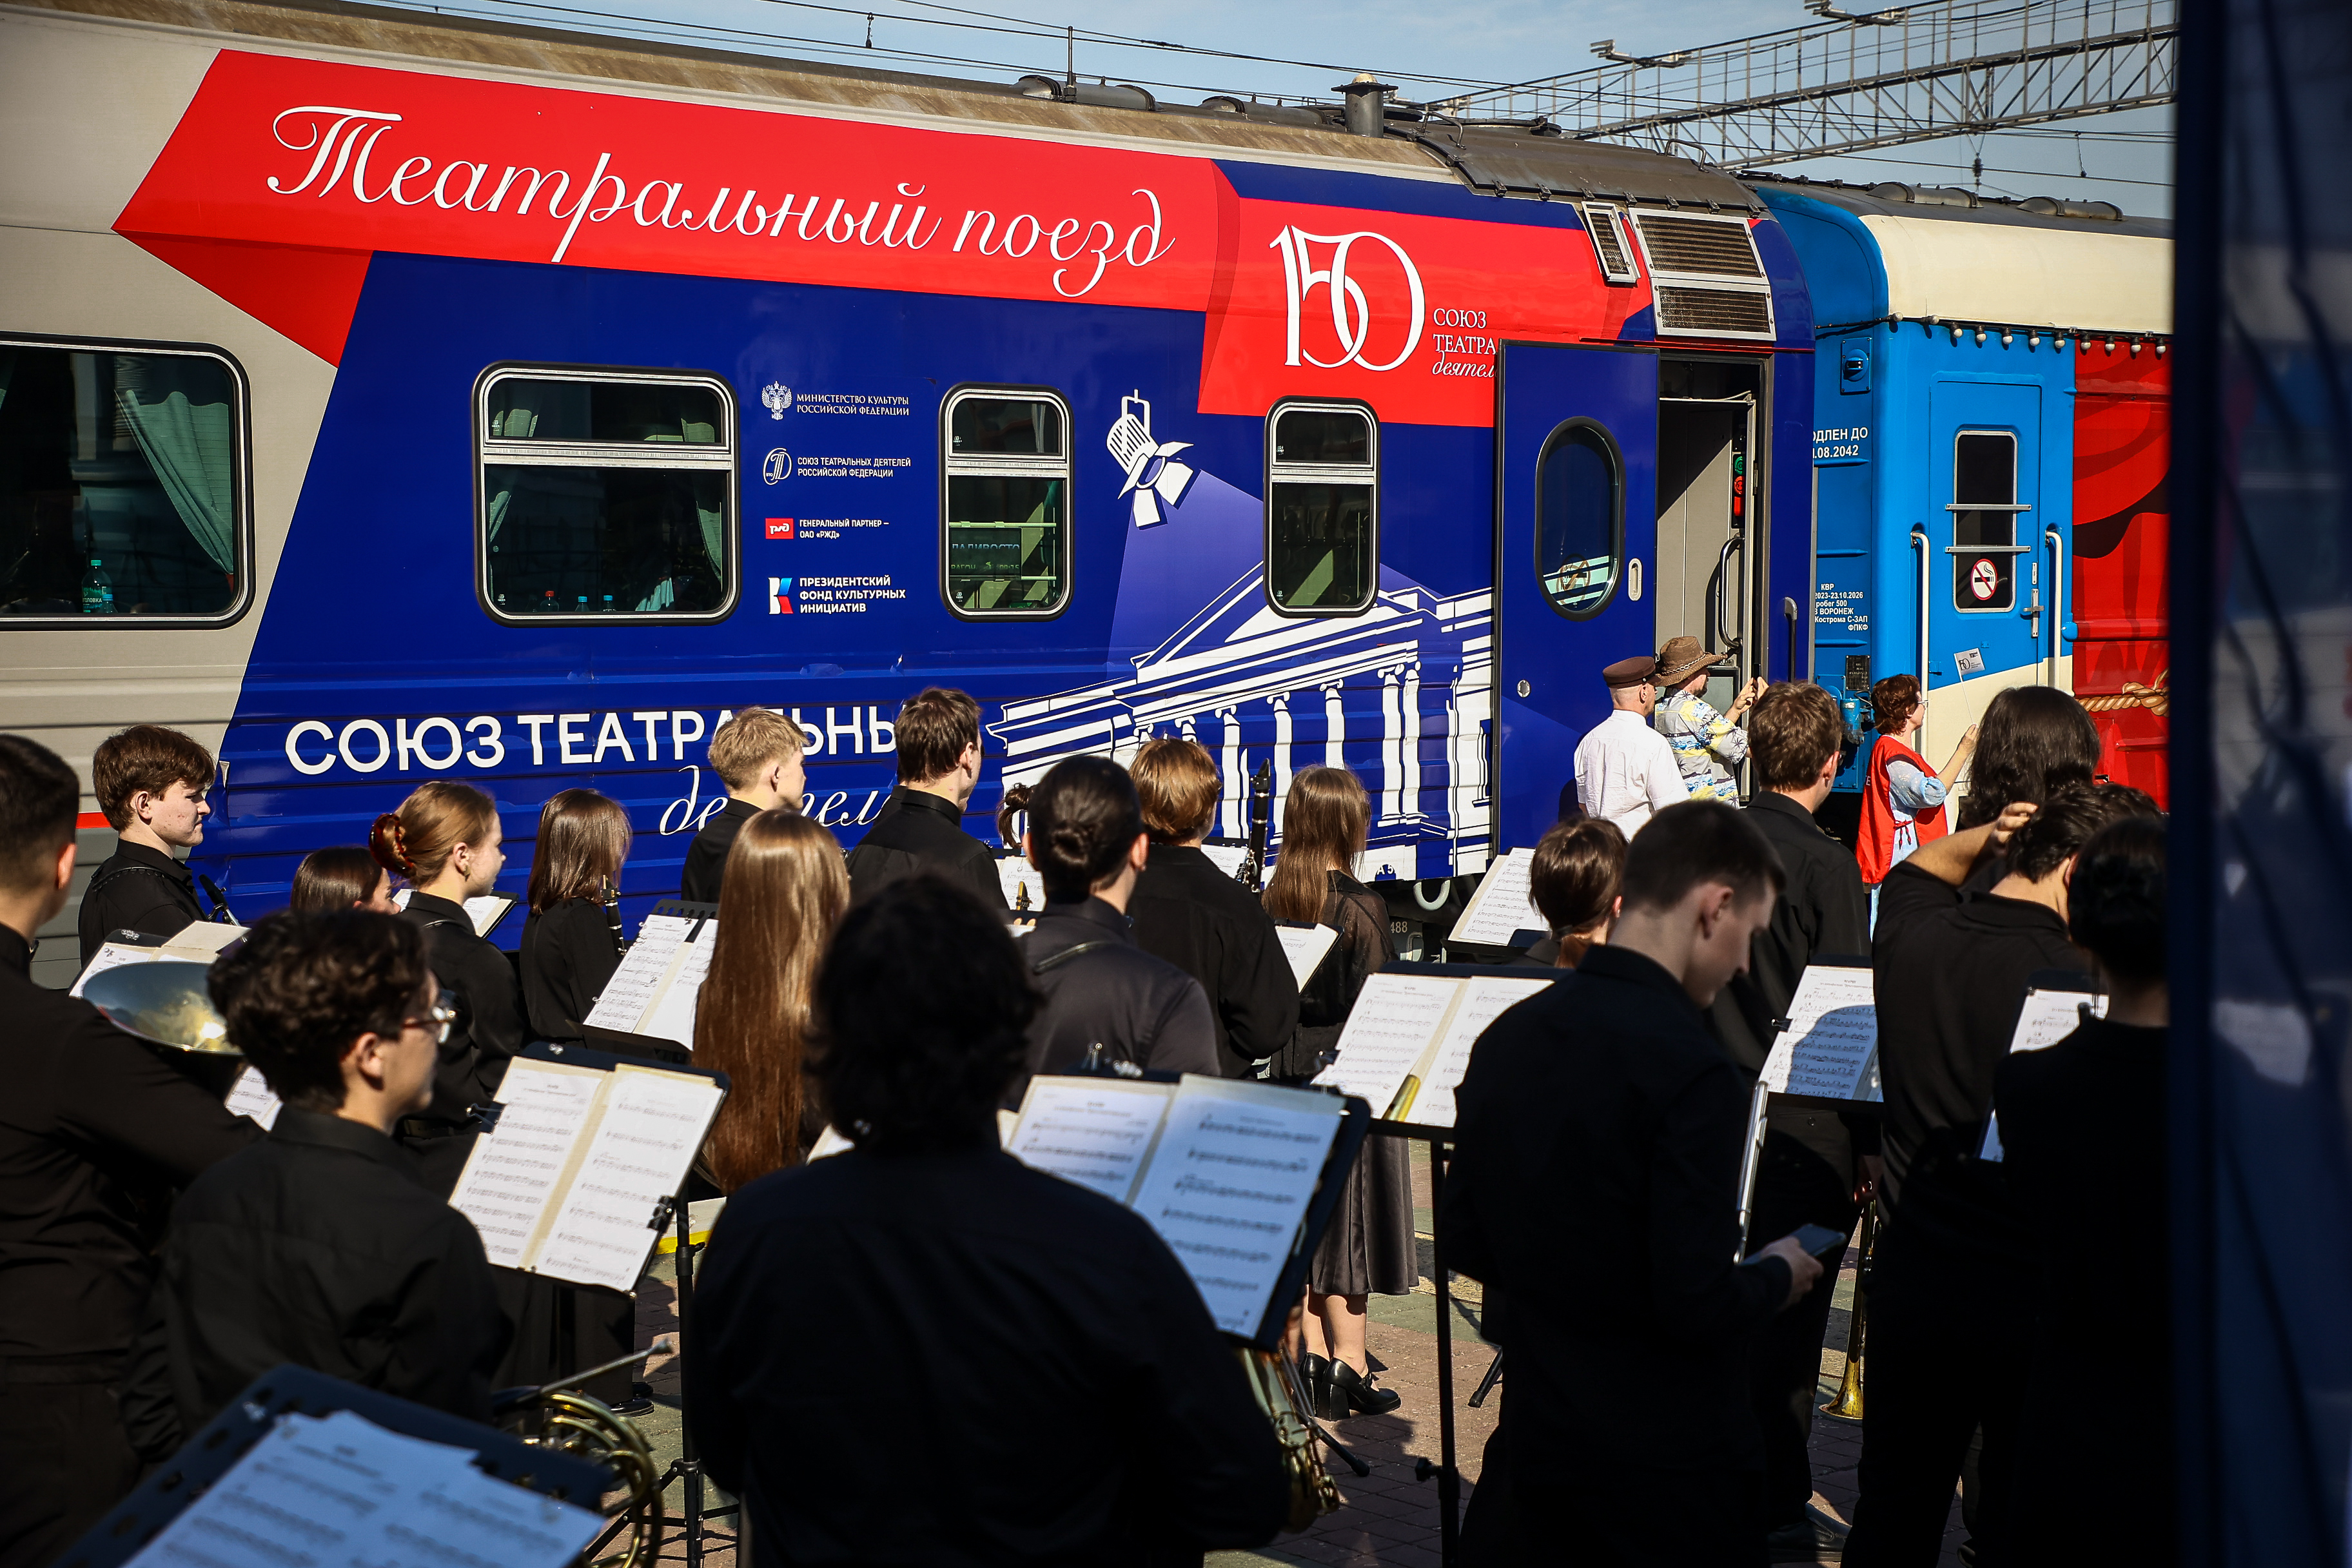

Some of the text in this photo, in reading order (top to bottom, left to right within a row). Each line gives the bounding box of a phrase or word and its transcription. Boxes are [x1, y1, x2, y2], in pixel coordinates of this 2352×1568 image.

[267, 105, 1175, 297] Театральный поезд
[1269, 224, 1425, 371] 150
[1433, 308, 1486, 329] СОЮЗ
[1433, 333, 1496, 355] ТЕАТРА
[796, 393, 909, 406] МИНИСТЕРСТВО КУЛЬТУРЫ
[797, 404, 909, 416] РОССИЙСКОЙ ФЕДЕРАЦИИ
[1850, 427, 1868, 442] ДО
[798, 457, 911, 467] СОЮЗ ТЕАТРАЛЬНЫХ ДЕЯТЕЛЕЙ
[798, 467, 894, 478] РОССИЙСКОЙ ФЕДЕРАЦИИ
[799, 518, 850, 528] ГЕНЕРАЛЬНЫЙ
[851, 519, 882, 527] ПАРТНЕР
[799, 530, 840, 540] ОАО «РЖД»
[799, 574, 890, 587] ПРЕЗИДЕНТСКИЙ
[799, 589, 906, 601] ФОНД КУЛЬТУРНЫХ
[800, 603, 867, 614] ИНИЦИАТИВ
[1815, 616, 1845, 624] Кострома
[286, 704, 897, 775] СОЮЗ ТЕАТРЬНЫ
